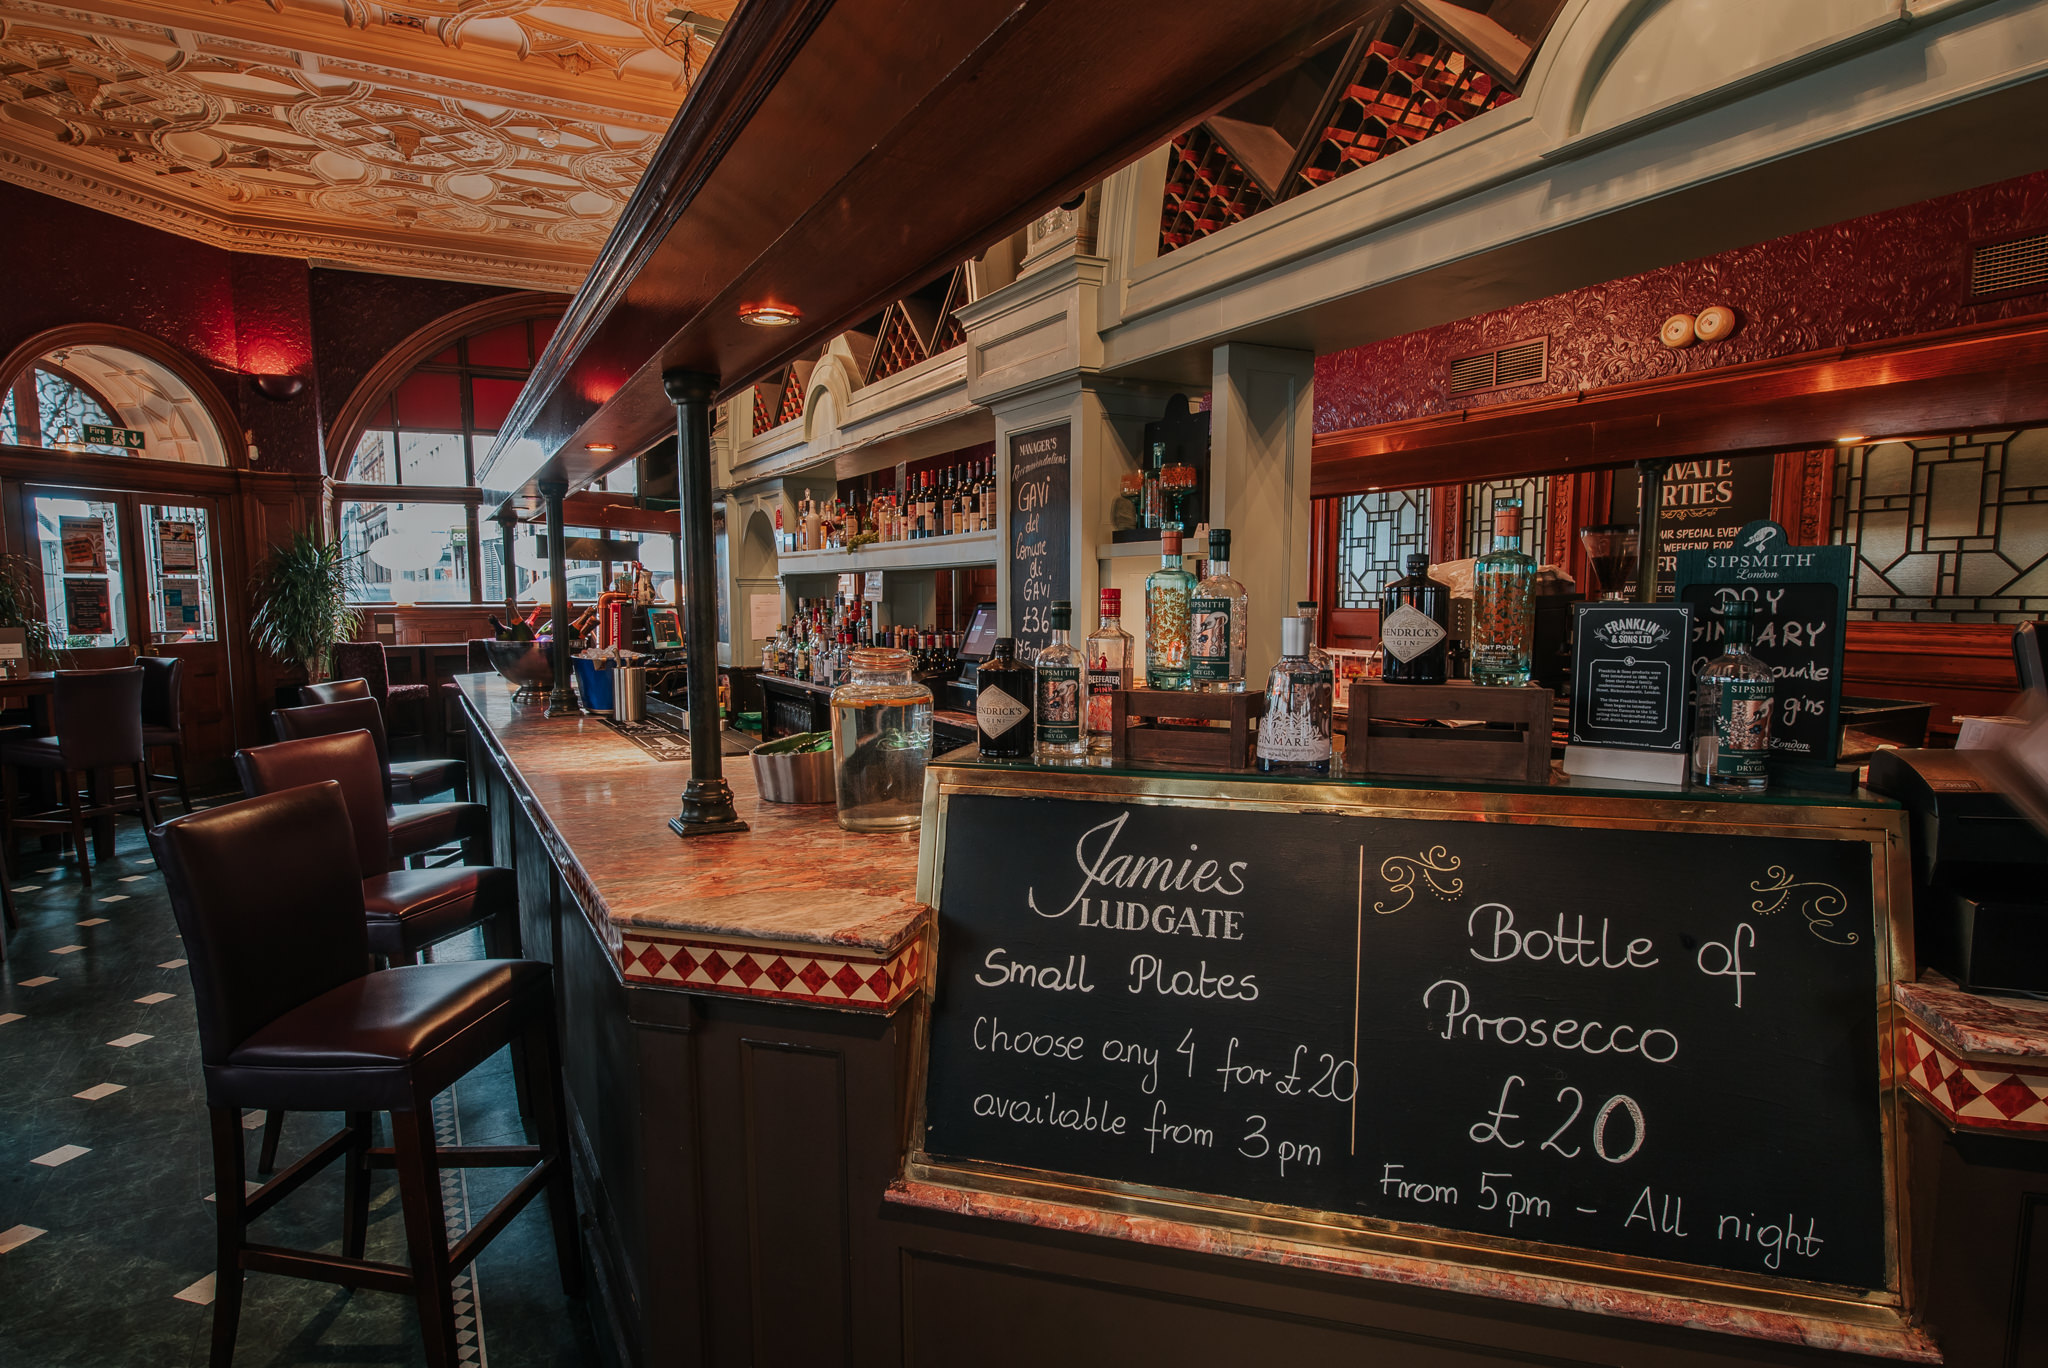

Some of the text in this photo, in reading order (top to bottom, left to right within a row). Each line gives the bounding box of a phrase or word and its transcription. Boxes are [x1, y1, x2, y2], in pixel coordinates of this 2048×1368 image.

[89, 426, 106, 435] Fire
[90, 436, 107, 444] exit
[1019, 437, 1057, 457] MANAGER'S
[1637, 480, 1733, 508] RTIES
[1676, 528, 1715, 539] SPECIAL
[1707, 553, 1812, 568] SIPSMITH
[1736, 568, 1779, 580] London
[1021, 606, 1050, 634] £36
[1604, 618, 1660, 635] FRANKLIN
[1611, 635, 1652, 644] & SONS LTD
[1088, 675, 1120, 685] BEEFEATER
[1094, 686, 1112, 694] PINK
[978, 706, 1022, 716] ENDRICK'S
[1273, 738, 1310, 746] MARE
[1770, 736, 1811, 750] London
[1028, 811, 1248, 918] Jamies
[1078, 897, 1244, 940] LUDGATE
[1468, 903, 1756, 1008] Bottle of
[974, 948, 1259, 1001] Small Plates
[1423, 979, 1678, 1063] Prosecco
[973, 1016, 1359, 1102] Choose any 4 for £20
[973, 1091, 1127, 1136] available
[1144, 1100, 1214, 1154] from
[1469, 1075, 1646, 1163] £20
[1379, 1162, 1458, 1204] From
[1624, 1186, 1688, 1237] All
[1718, 1212, 1824, 1269] night
